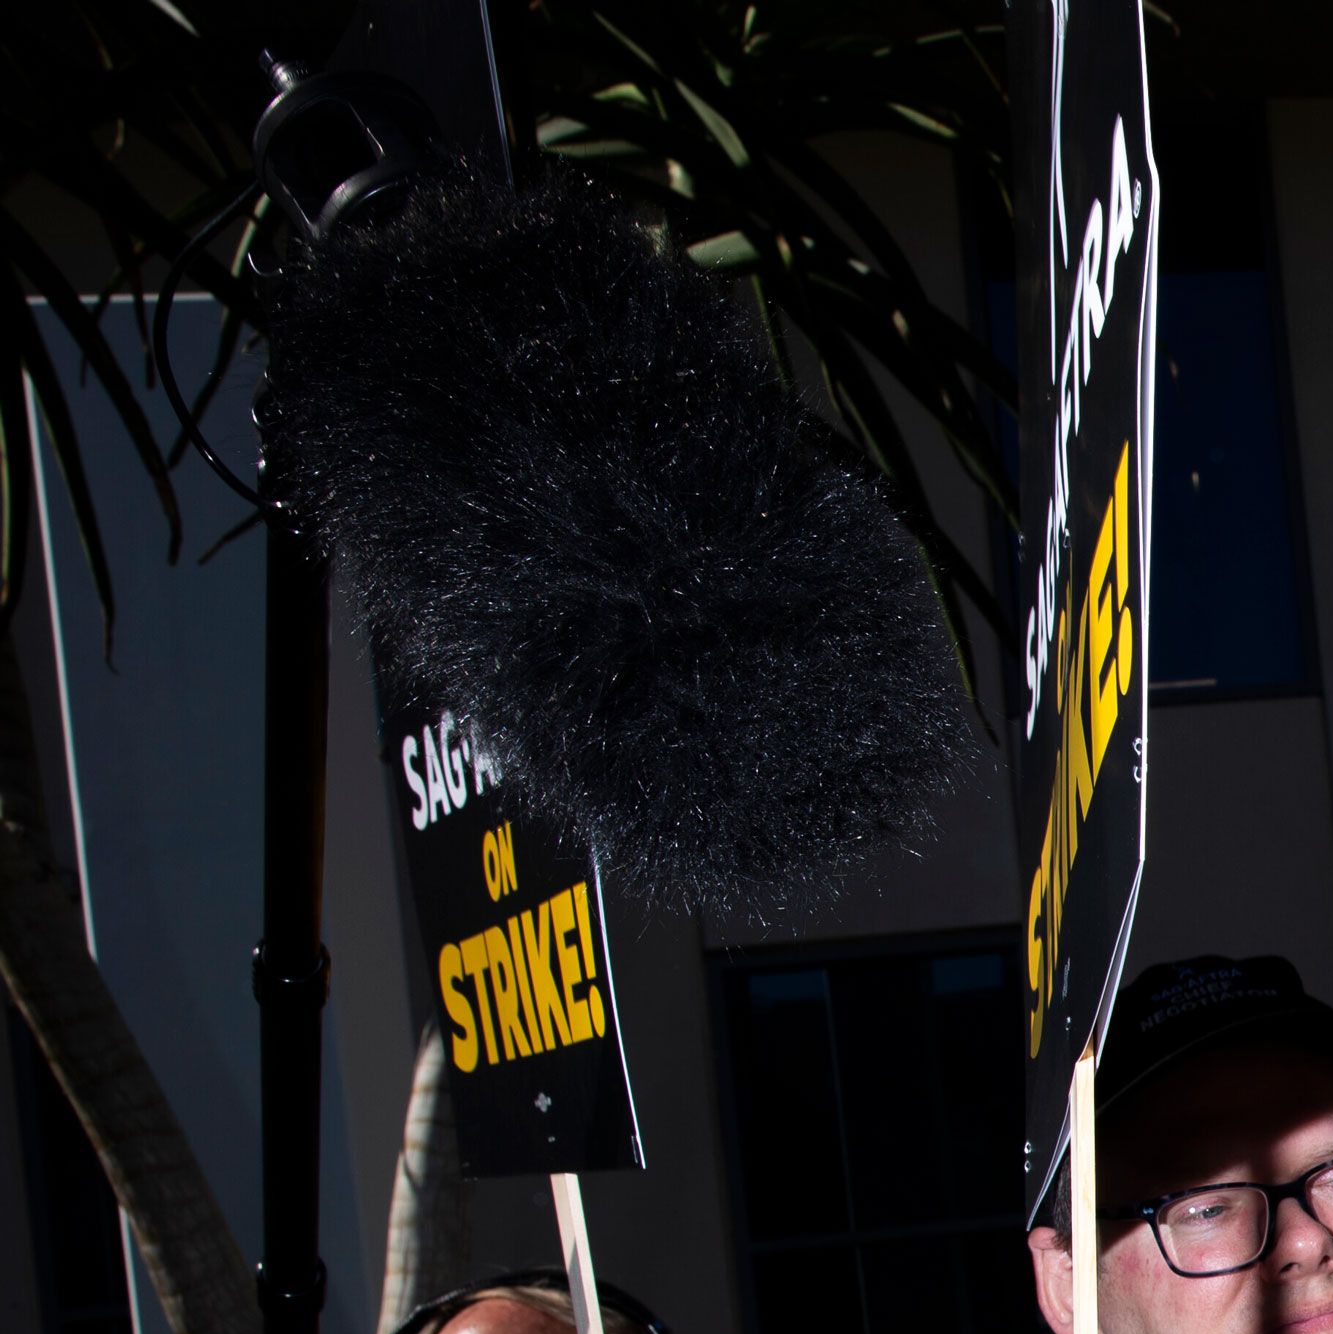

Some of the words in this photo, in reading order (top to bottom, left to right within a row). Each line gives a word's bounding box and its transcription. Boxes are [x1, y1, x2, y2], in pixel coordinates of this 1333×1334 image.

[1027, 439, 1132, 1060] STRIKE!
[482, 818, 518, 903] ON
[438, 880, 606, 1074] STRIKE!
